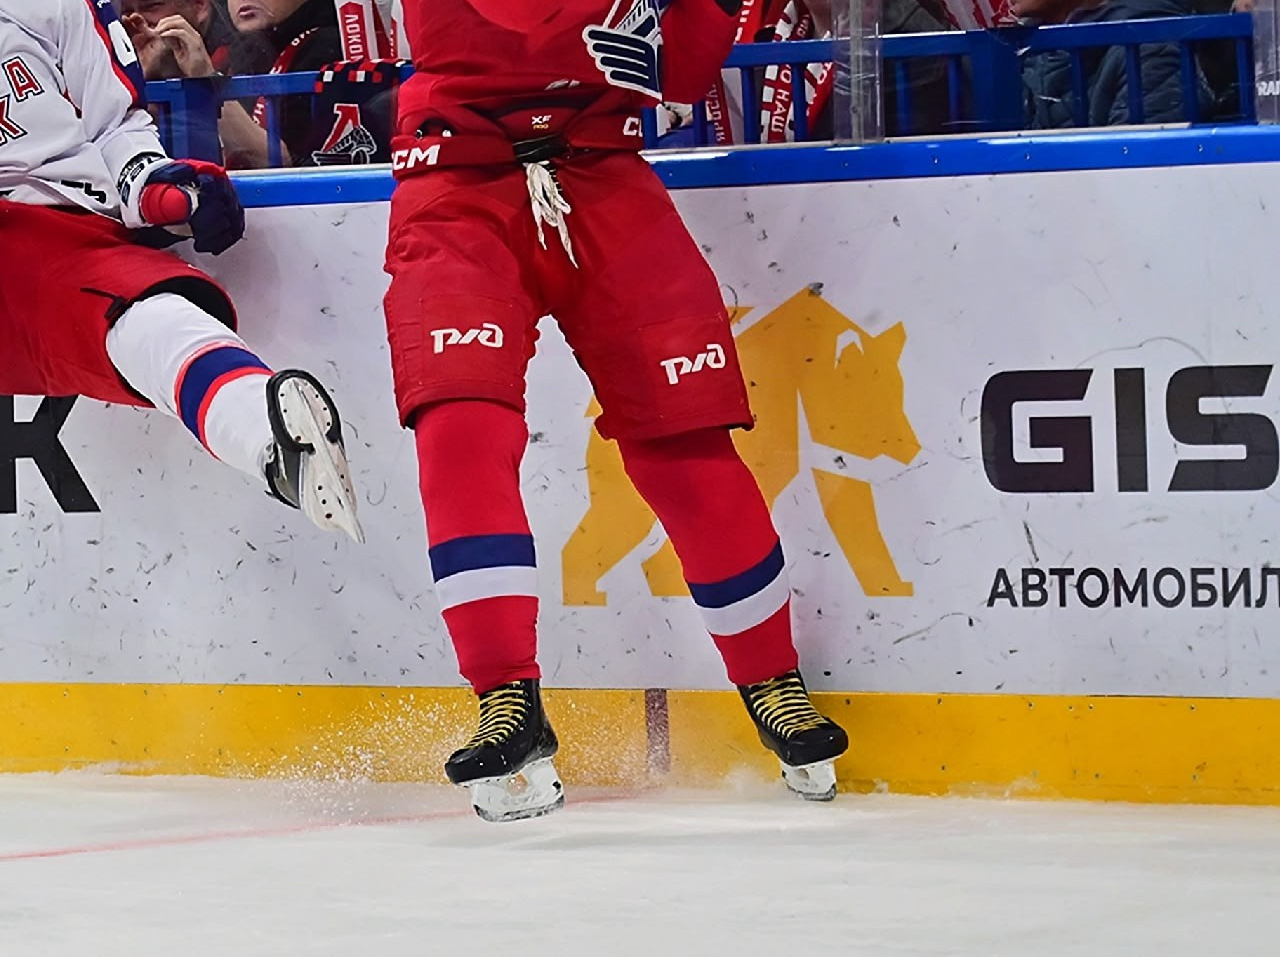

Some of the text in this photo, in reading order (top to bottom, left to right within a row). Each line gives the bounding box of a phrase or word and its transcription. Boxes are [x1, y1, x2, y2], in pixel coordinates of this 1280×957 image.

[771, 89, 790, 133] НАШ
[391, 144, 440, 171] CM
[980, 364, 1280, 493] GIS
[986, 567, 1280, 609] АВТОМОБИЛ
